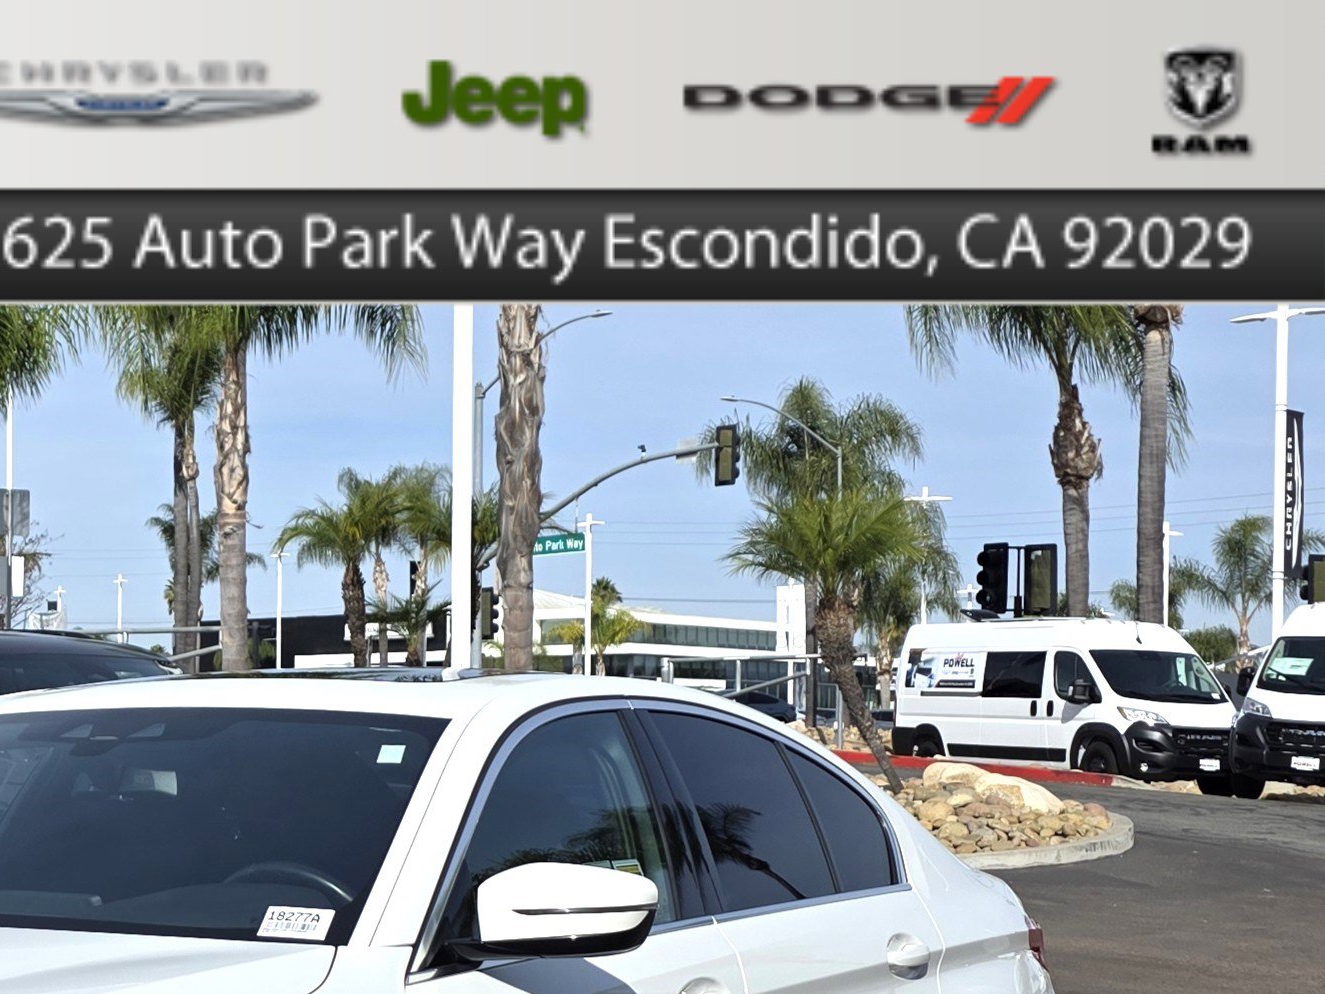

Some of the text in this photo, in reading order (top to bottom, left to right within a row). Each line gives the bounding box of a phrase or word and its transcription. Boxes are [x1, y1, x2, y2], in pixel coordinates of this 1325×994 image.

[545, 540, 564, 551] Park
[566, 538, 583, 550] Way
[943, 658, 975, 668] POWELL
[268, 911, 321, 923] 18277A
